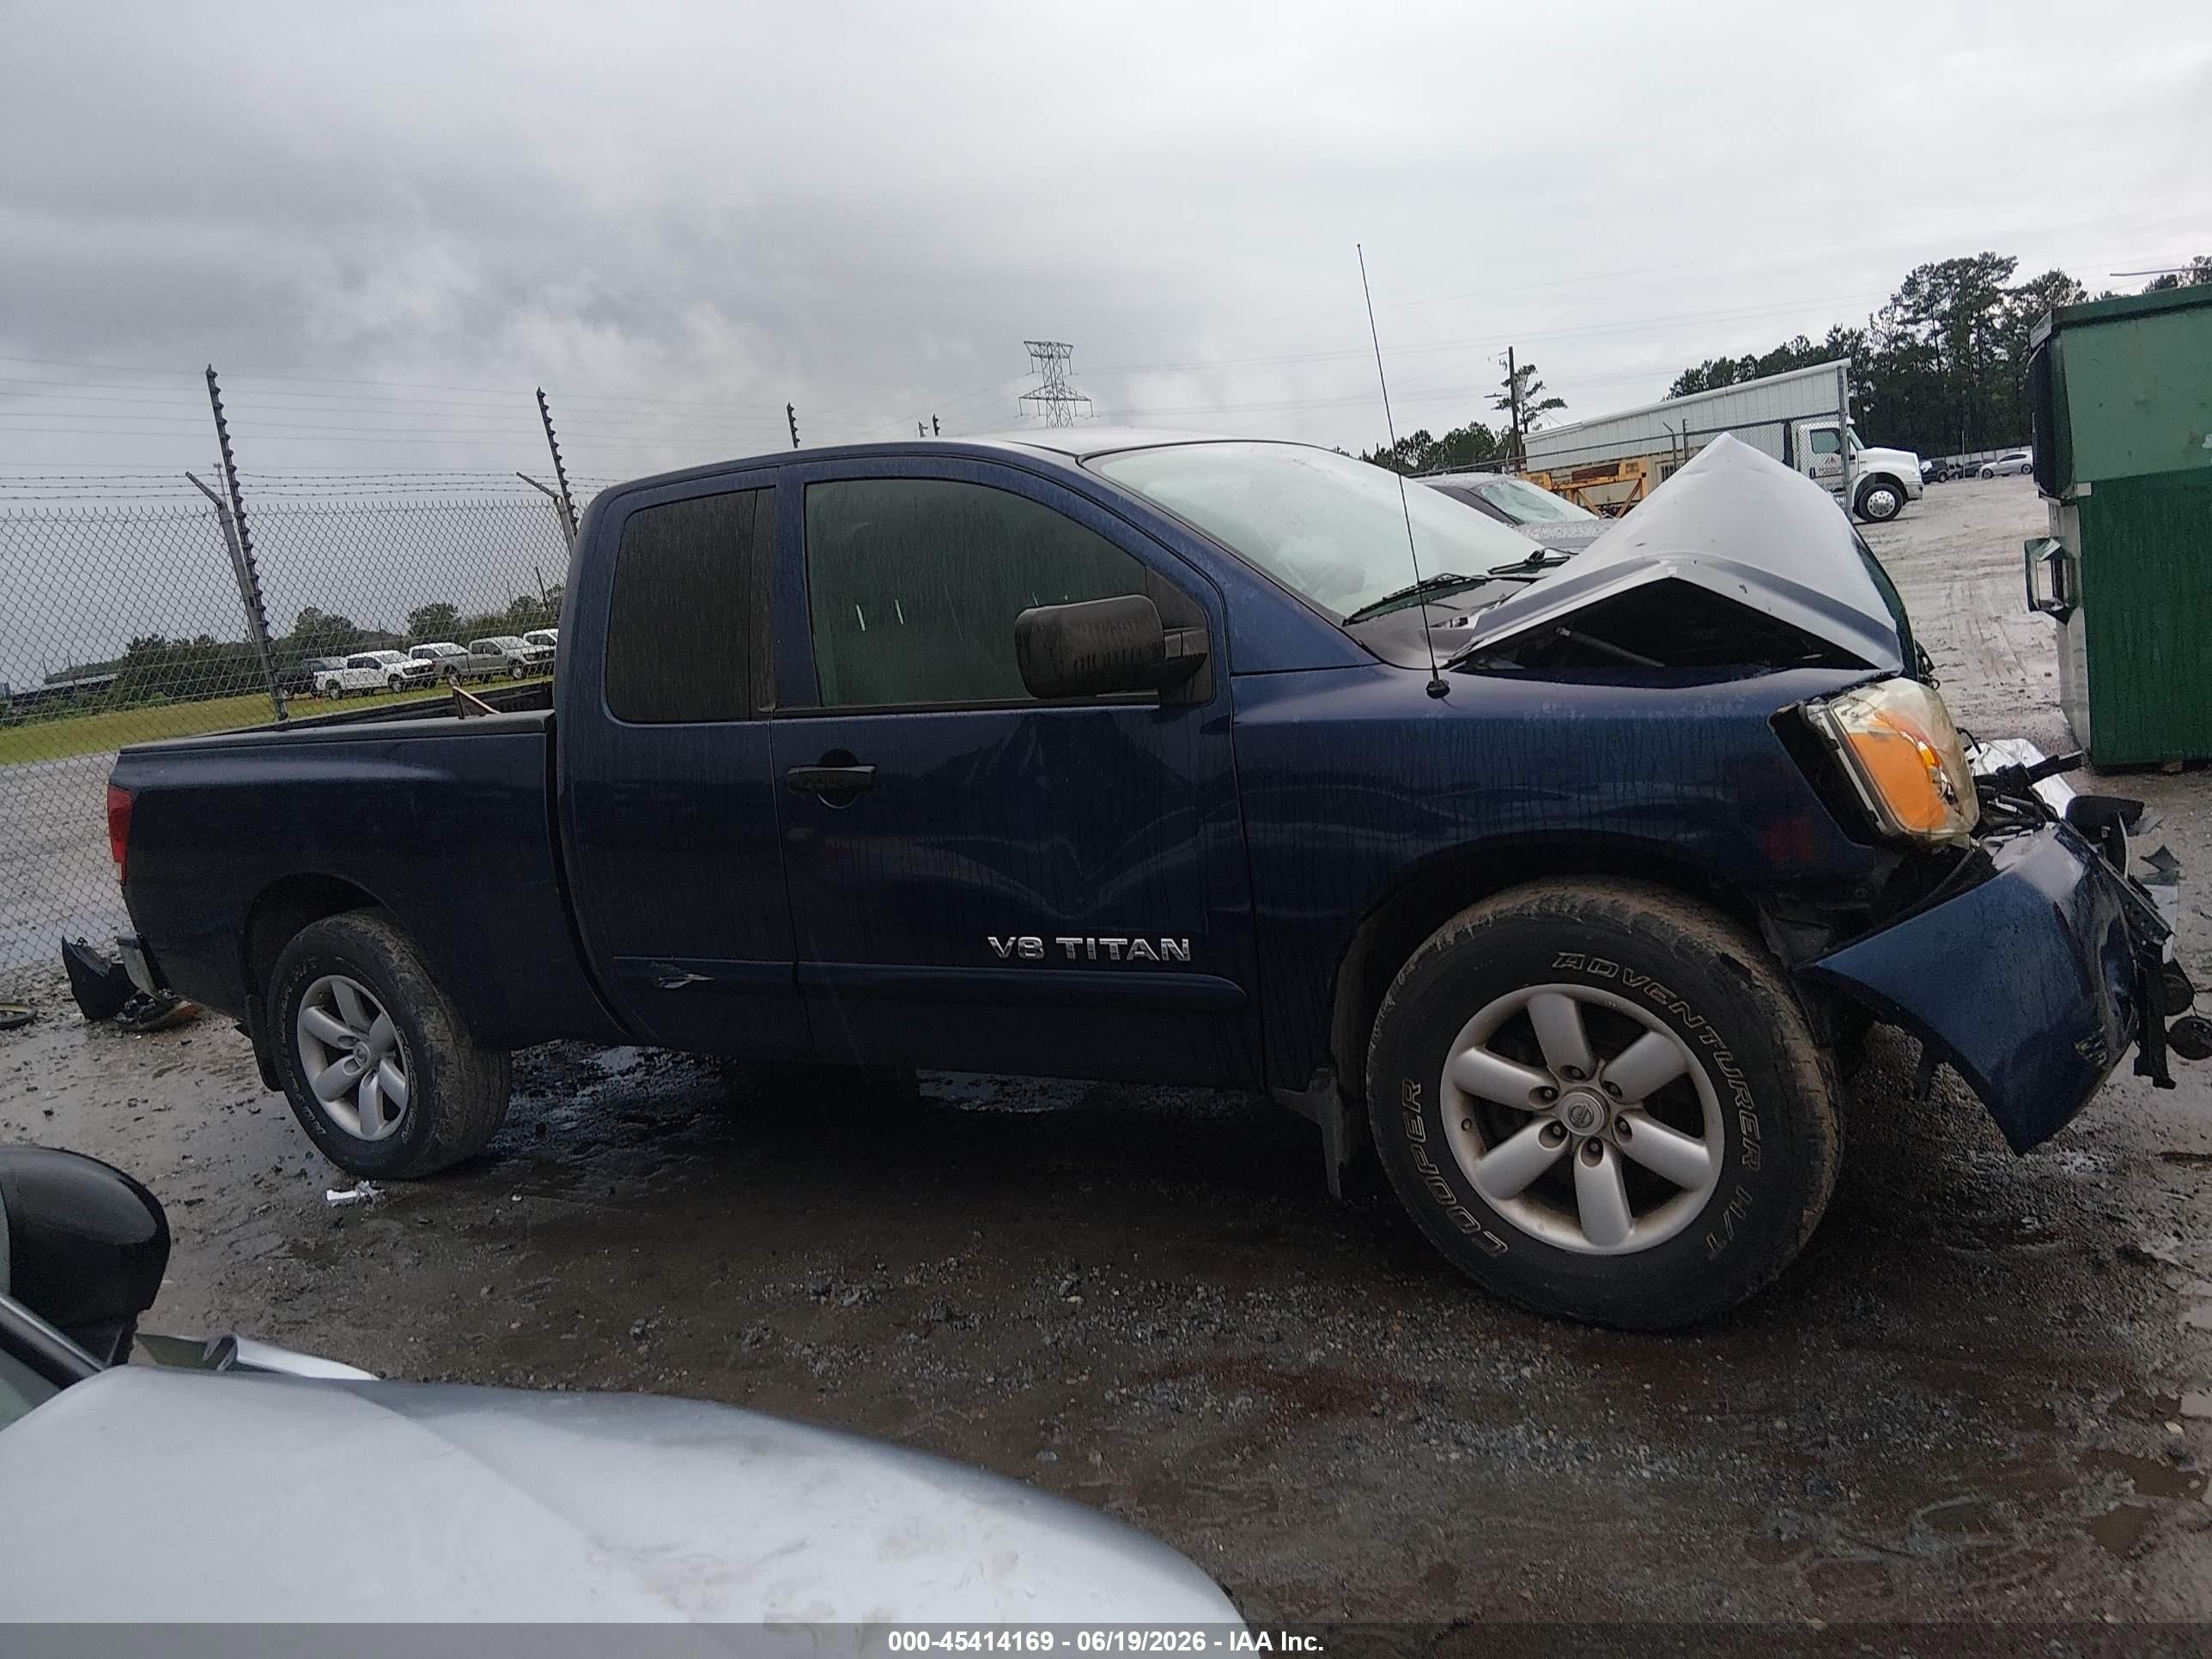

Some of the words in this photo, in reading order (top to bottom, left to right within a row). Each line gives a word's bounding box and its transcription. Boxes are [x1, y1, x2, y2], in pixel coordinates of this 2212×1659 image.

[988, 935, 1044, 960] V8
[1055, 937, 1191, 963] TITAN
[1552, 951, 1761, 1171] ADVENTURER
[1401, 1077, 1509, 1258] COOPER
